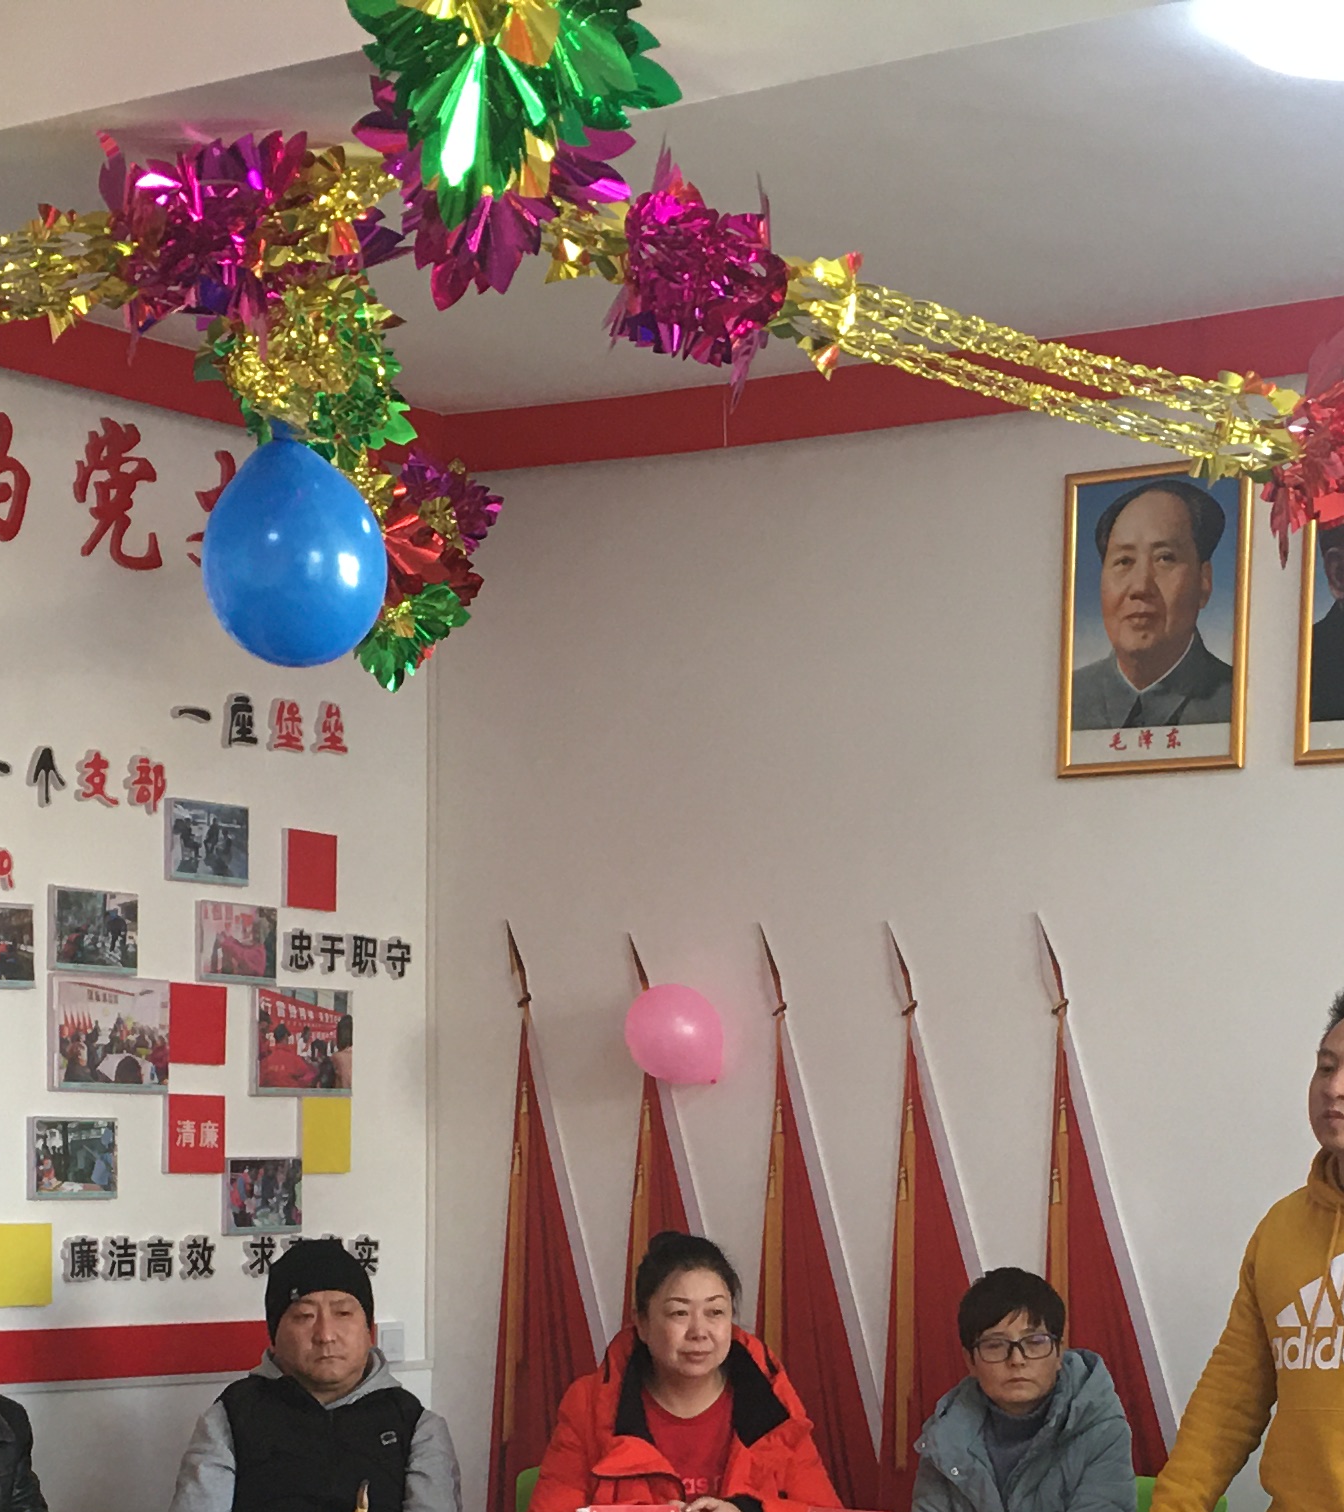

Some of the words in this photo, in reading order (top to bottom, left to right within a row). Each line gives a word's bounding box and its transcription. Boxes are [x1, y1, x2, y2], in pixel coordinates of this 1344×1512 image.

[178, 695, 348, 754] 一座堡垒
[1108, 727, 1181, 751] 毛泽东
[290, 931, 413, 979] 忠于职守
[175, 1120, 220, 1149] 清廉
[69, 1237, 215, 1278] 廉洁高效
[248, 1236, 380, 1275] 求实
